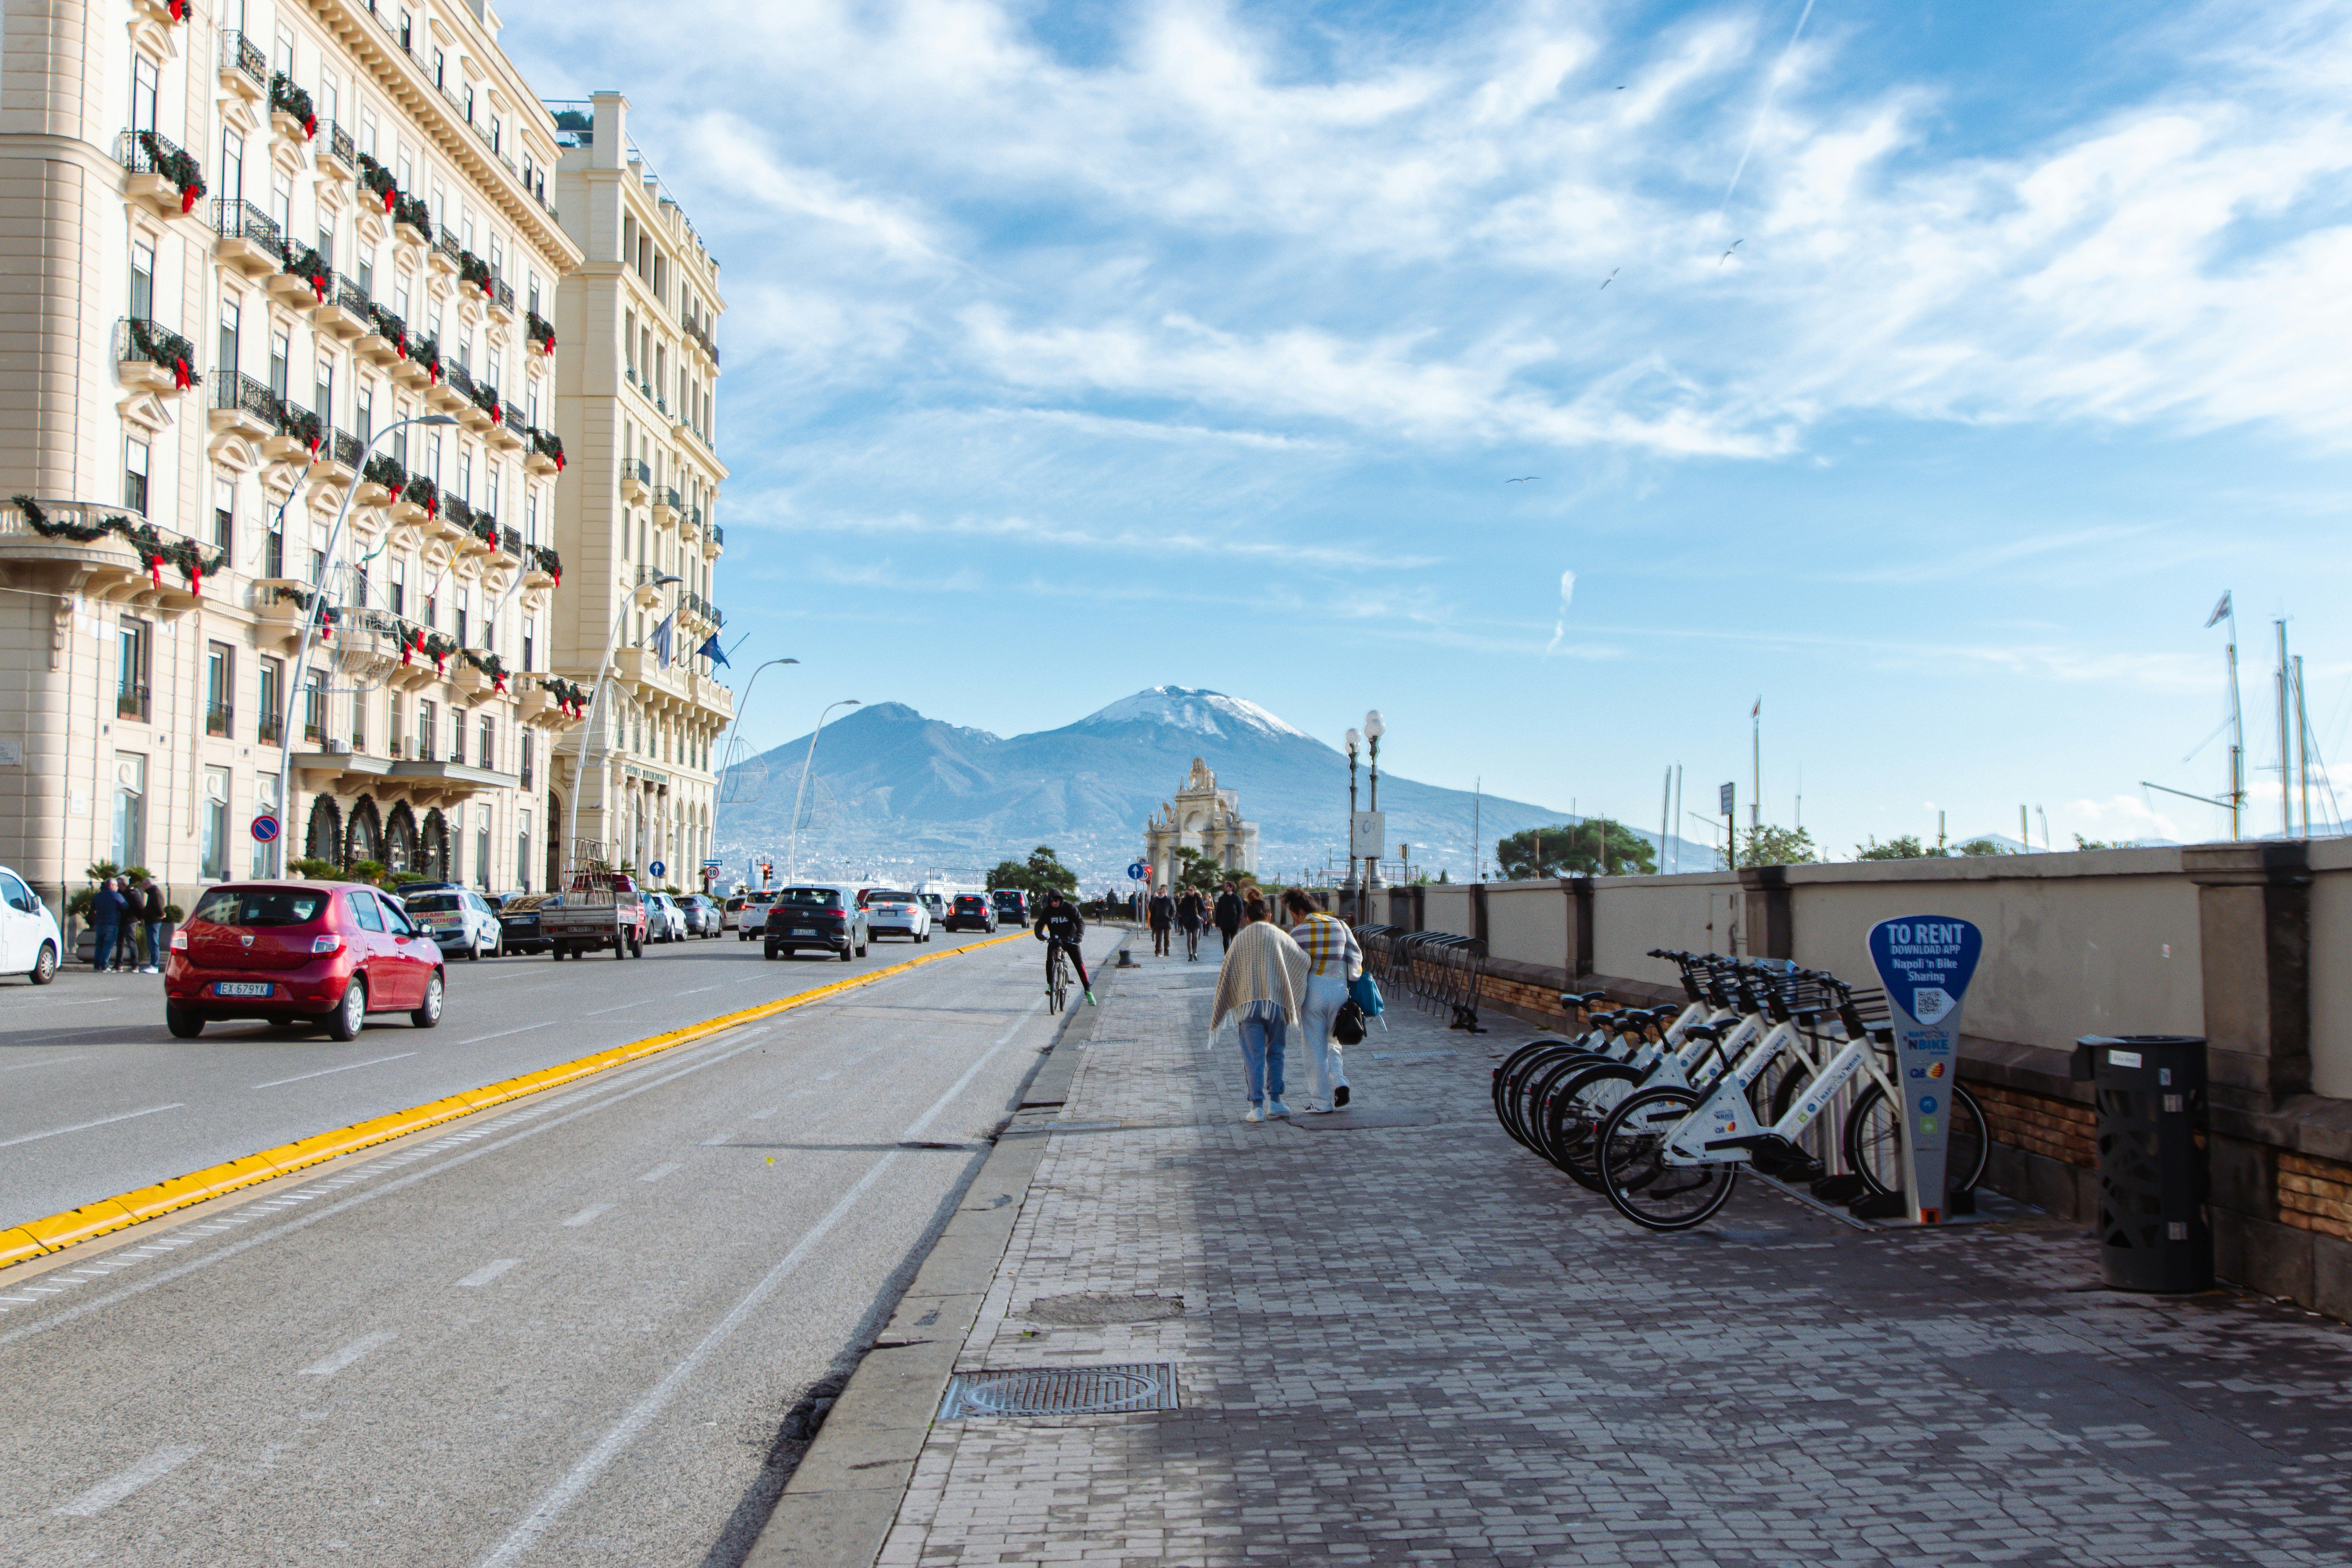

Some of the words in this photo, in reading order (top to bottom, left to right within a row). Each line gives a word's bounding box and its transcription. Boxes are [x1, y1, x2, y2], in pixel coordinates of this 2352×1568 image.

[1886, 924, 1911, 944] TO
[1915, 923, 1965, 944] RENT
[1890, 945, 1941, 955] DOWNLOAD
[1942, 944, 1961, 954] APP
[1893, 958, 1924, 971] Napoli
[1935, 958, 1958, 969] Bike
[1907, 971, 1945, 984] Sharing
[222, 984, 234, 994] EX
[237, 984, 266, 994] 679YK
